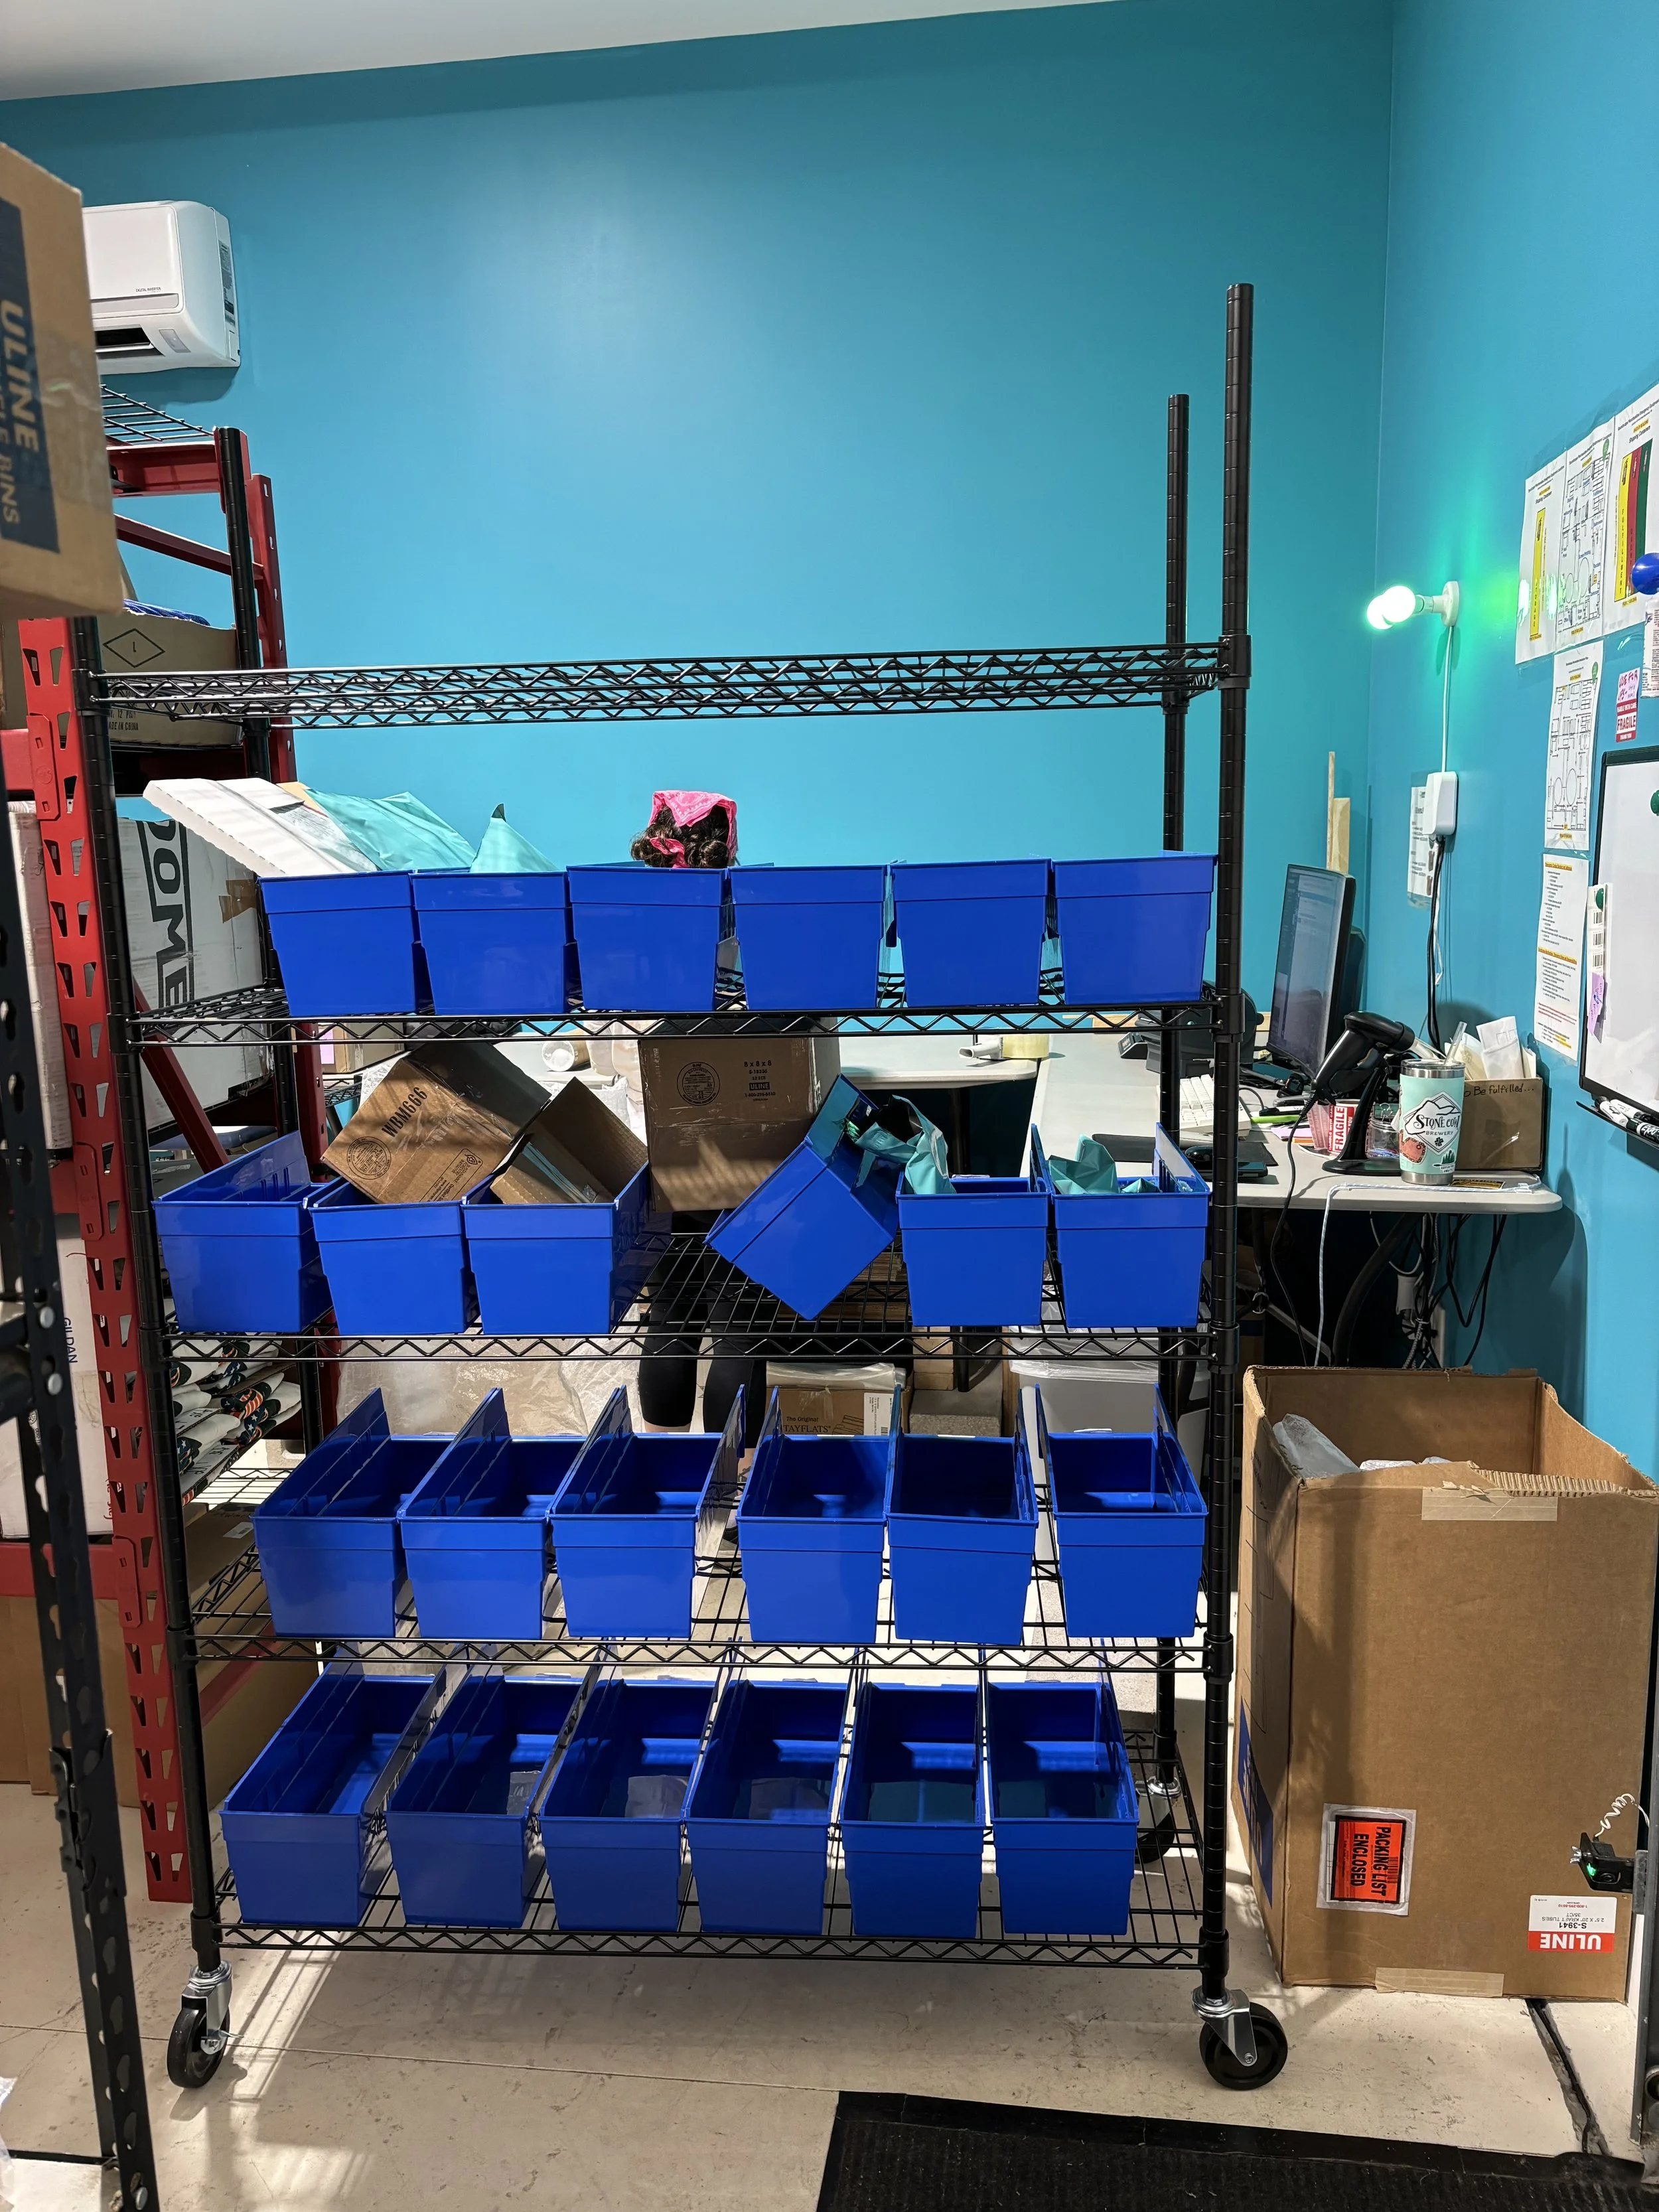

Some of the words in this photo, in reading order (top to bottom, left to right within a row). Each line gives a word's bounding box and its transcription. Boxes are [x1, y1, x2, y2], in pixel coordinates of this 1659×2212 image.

[1, 299, 40, 453] ULINE
[1617, 715, 1636, 731] FRAGILE
[1473, 1086, 1486, 1096] Be
[382, 1086, 428, 1138] WBM666
[1334, 1106, 1345, 1151] FRAGILE
[1413, 1114, 1445, 1130] STONE
[64, 1317, 78, 1364] GILDAN
[783, 1424, 828, 1433] TAYFLATS
[1350, 1833, 1370, 1887] ENCLOSED
[1372, 1826, 1392, 1871] PACKING
[1370, 1873, 1388, 1897] LIST
[1540, 1933, 1602, 1951] ULINE
